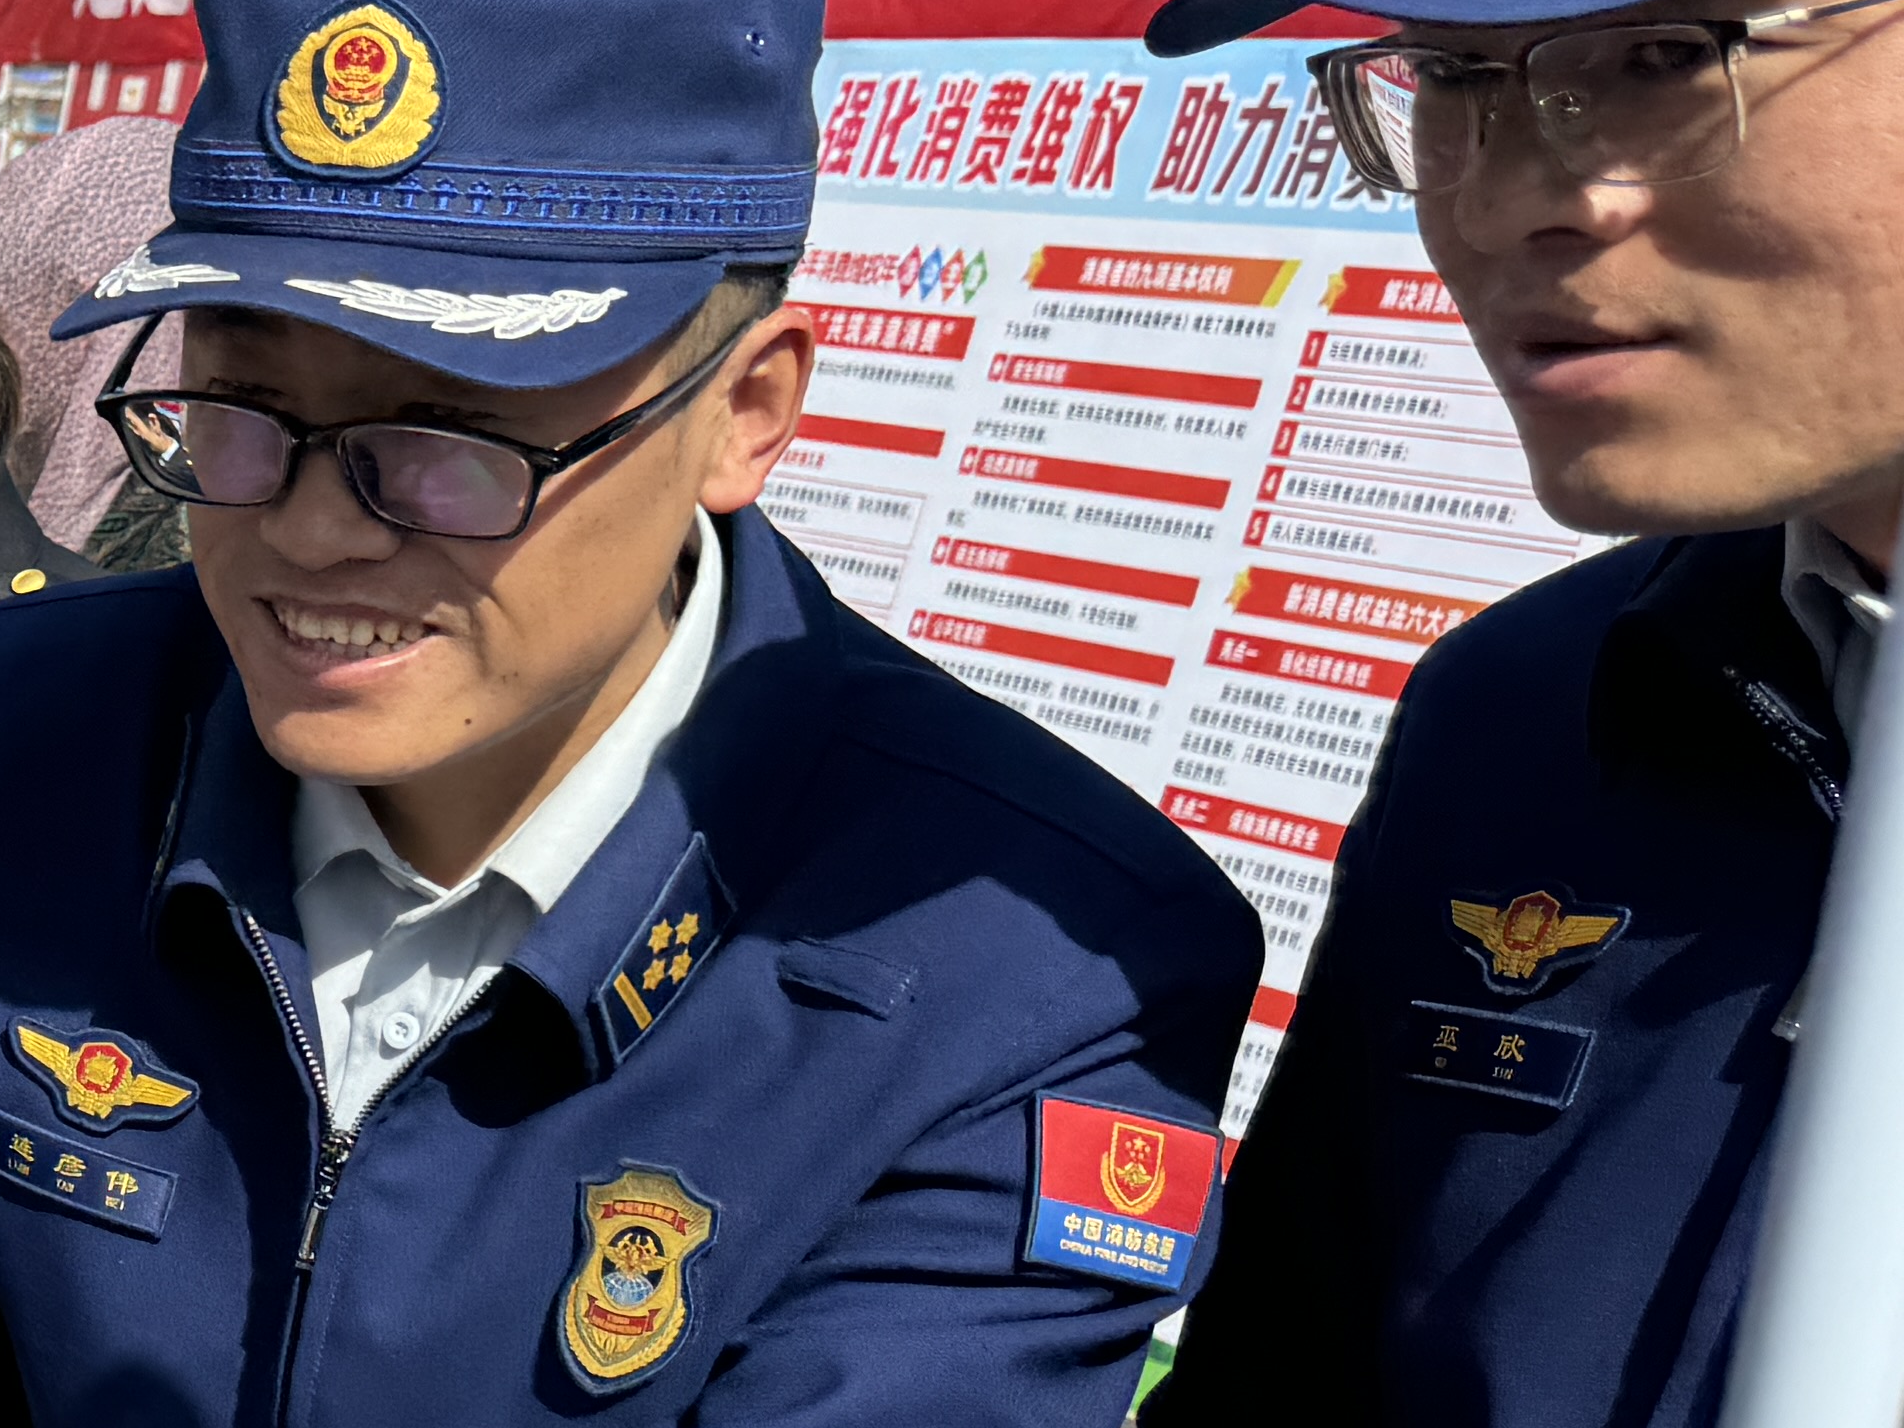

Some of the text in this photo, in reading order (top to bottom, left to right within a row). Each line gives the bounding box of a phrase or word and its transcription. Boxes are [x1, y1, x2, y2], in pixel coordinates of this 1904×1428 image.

[818, 74, 1147, 193] 强化消费维权
[1378, 277, 1460, 314] 解决消费
[1063, 1212, 1177, 1262] 中国消防救援
